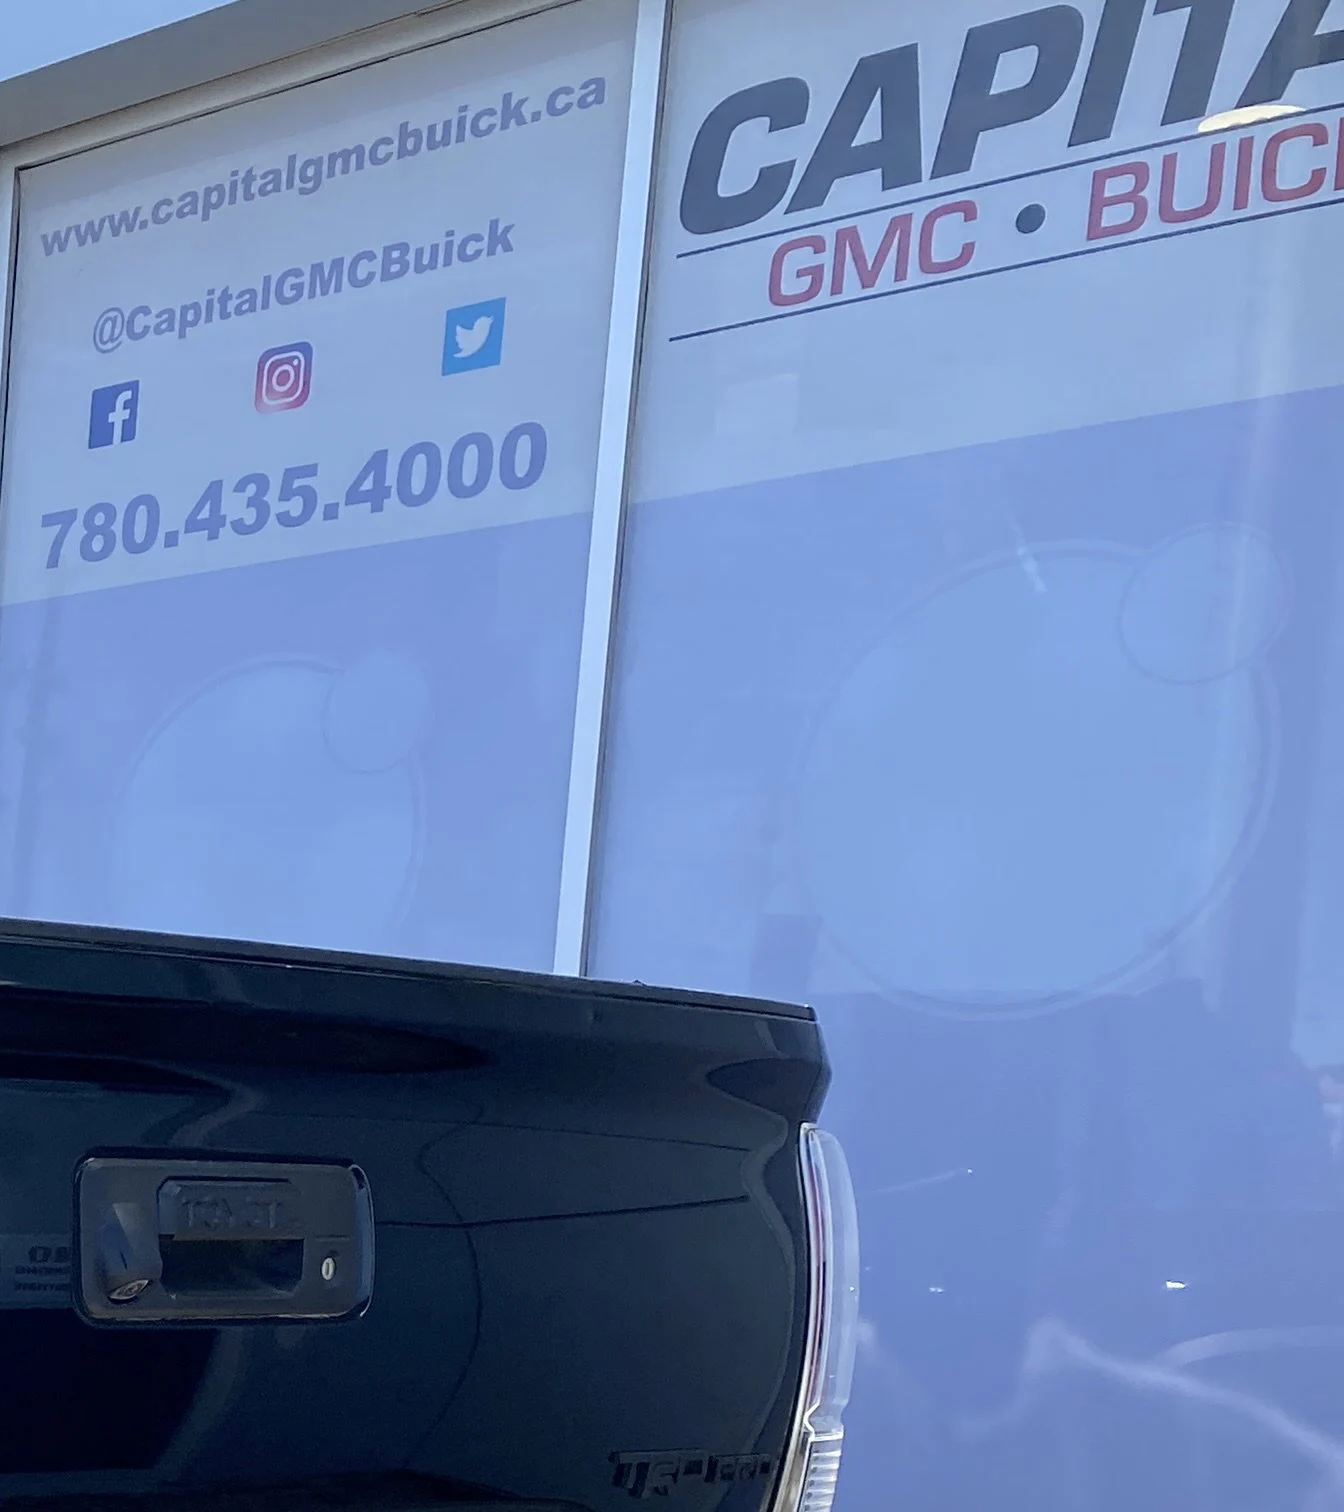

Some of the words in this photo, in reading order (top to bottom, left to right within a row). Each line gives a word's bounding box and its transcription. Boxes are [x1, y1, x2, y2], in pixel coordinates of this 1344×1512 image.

[40, 76, 607, 258] www.capitalgmcbuick.ca
[767, 199, 978, 307] GMC
[1086, 122, 1344, 242] BUIC
[92, 217, 515, 354] @CapitalGMCBuick
[40, 421, 548, 569] 780.435.4000
